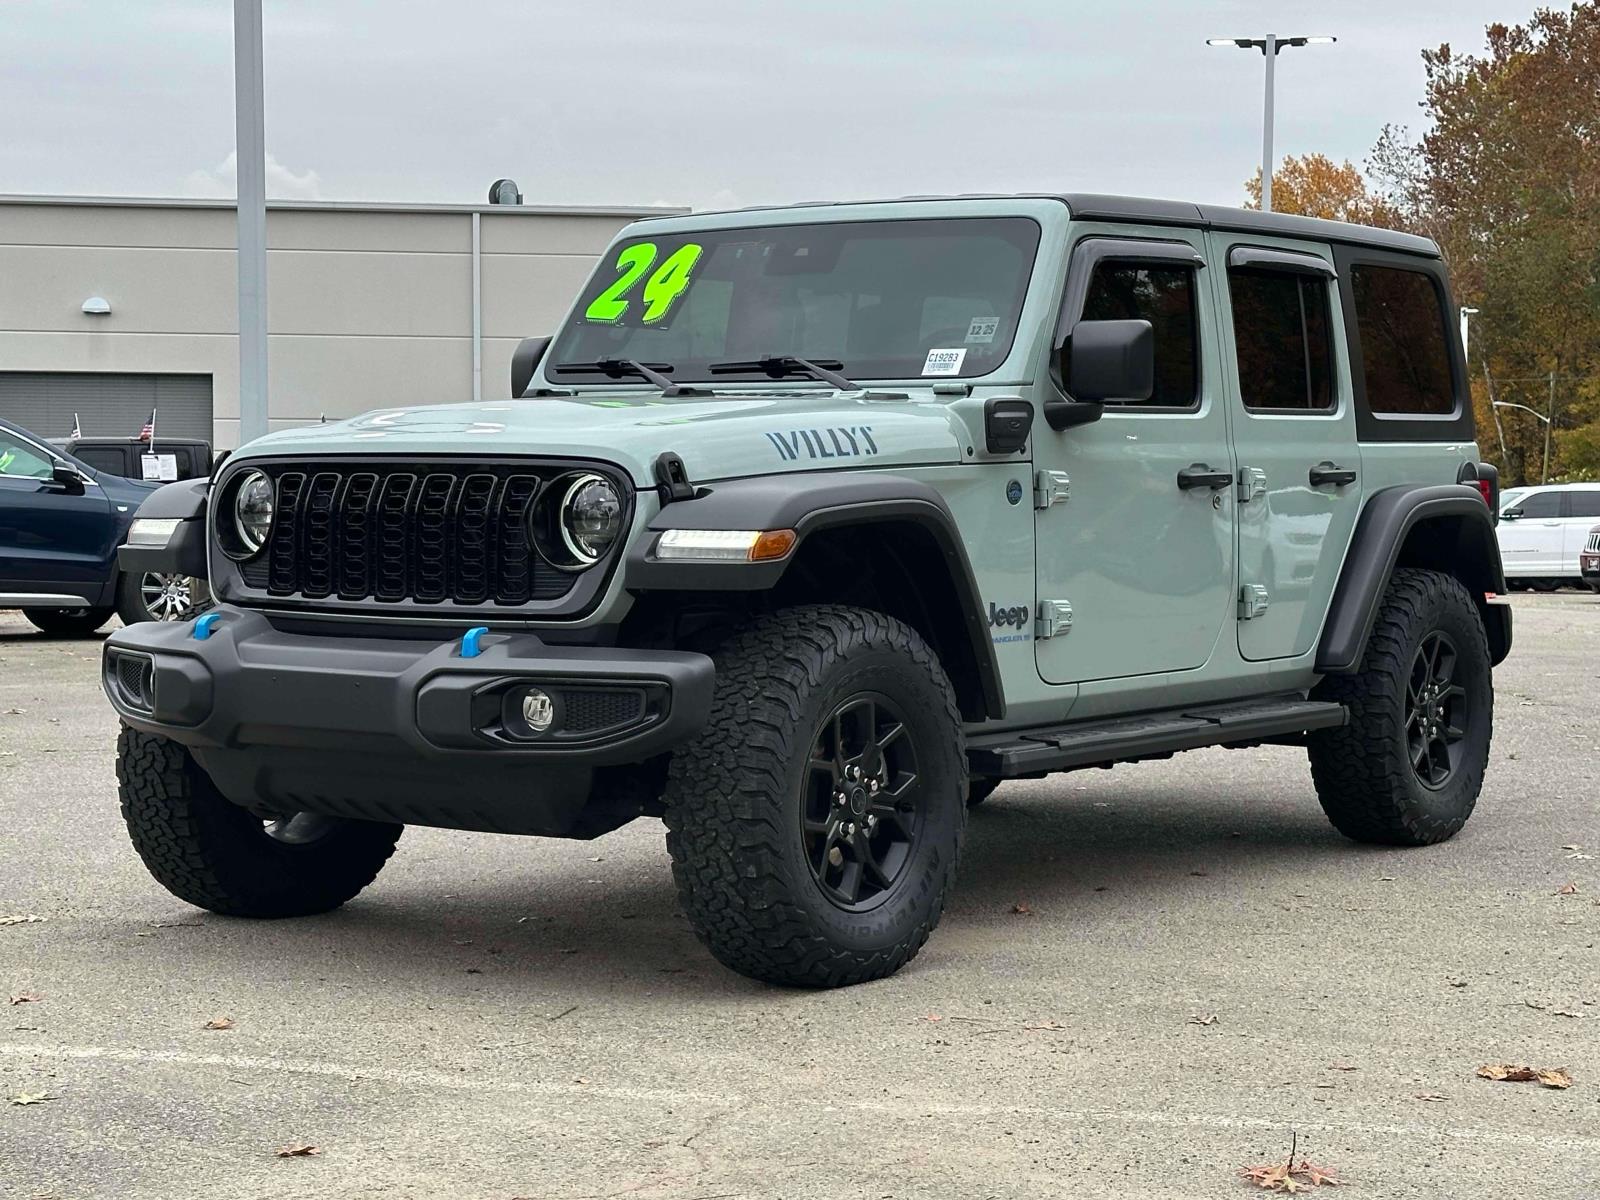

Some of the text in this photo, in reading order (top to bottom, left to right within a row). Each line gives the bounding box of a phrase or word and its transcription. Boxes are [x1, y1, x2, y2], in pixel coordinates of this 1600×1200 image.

[585, 242, 704, 325] 24
[928, 353, 959, 362] C19283
[765, 426, 878, 461] WILLYS
[987, 602, 1029, 630] Jeep
